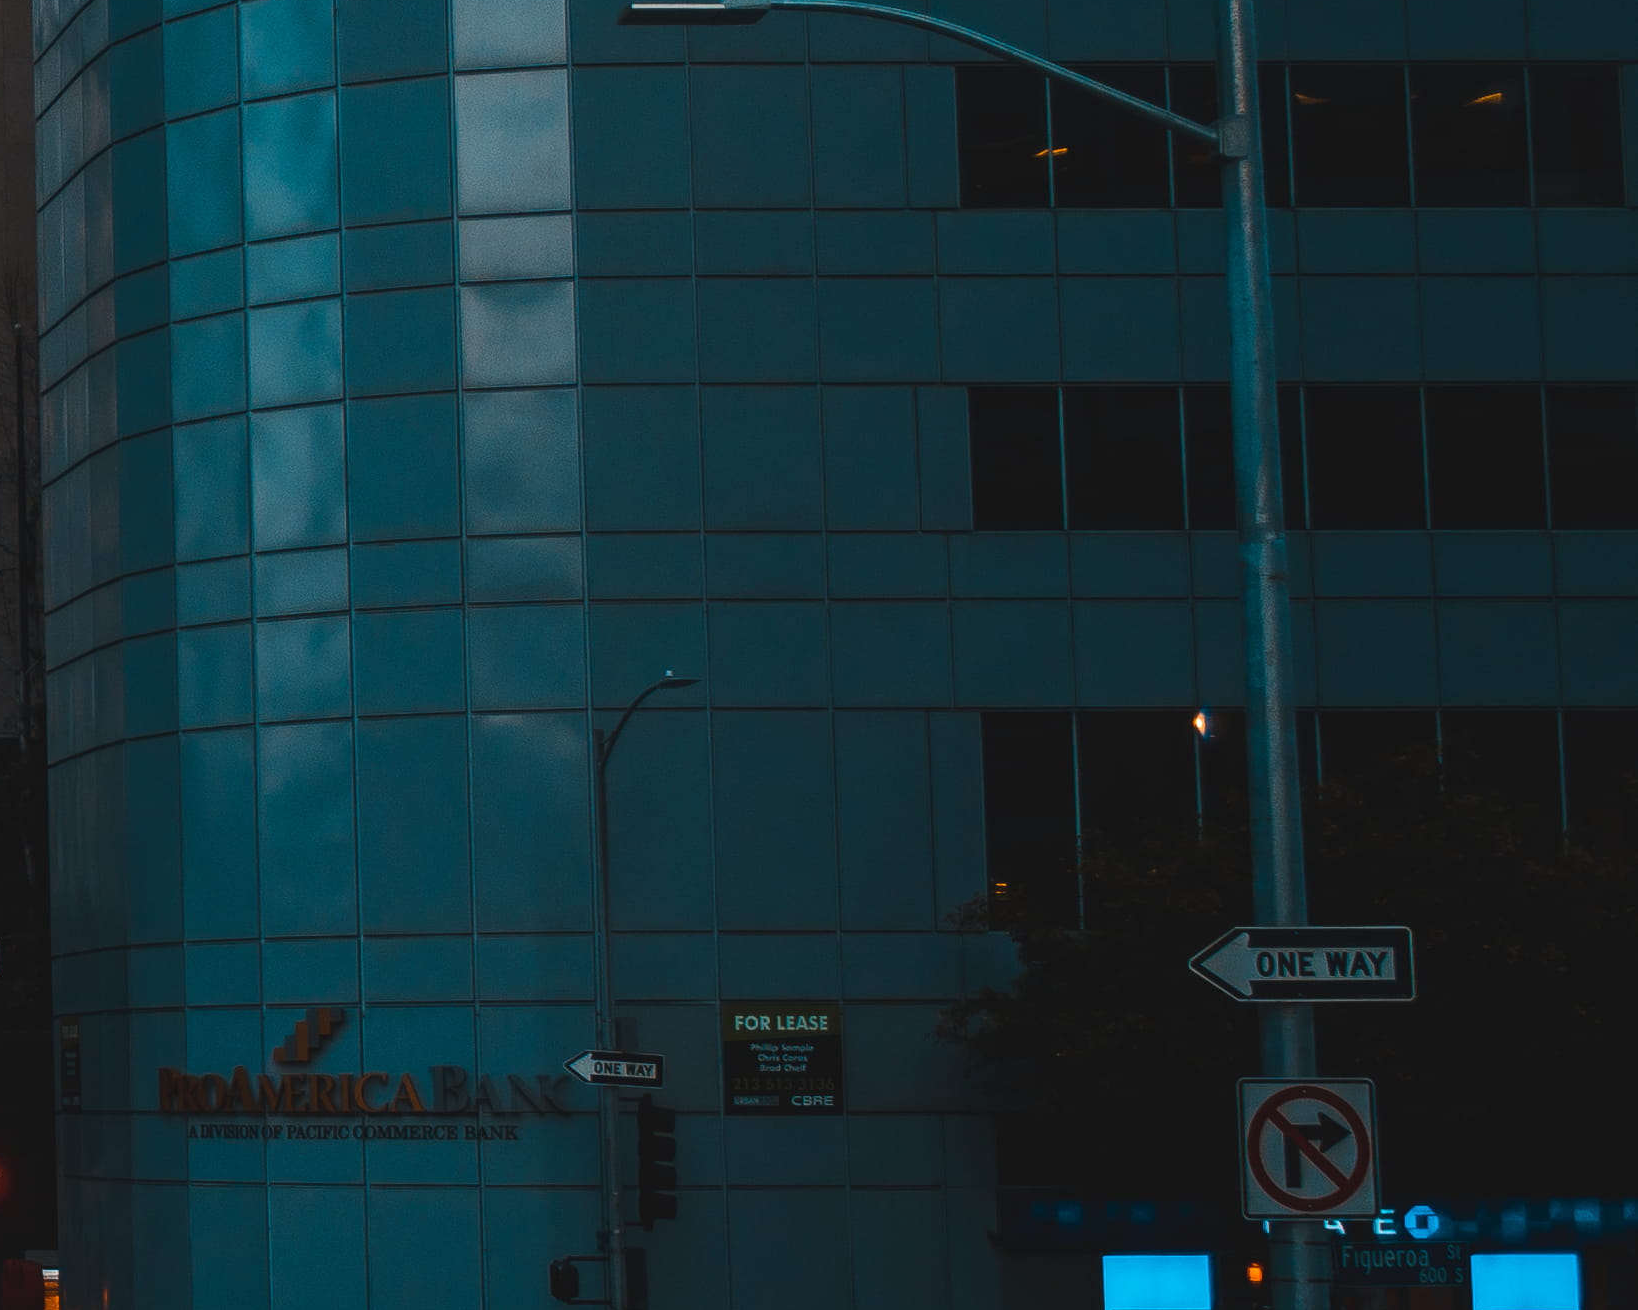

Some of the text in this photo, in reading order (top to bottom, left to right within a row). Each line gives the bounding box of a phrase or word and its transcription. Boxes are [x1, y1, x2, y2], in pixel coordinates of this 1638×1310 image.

[1256, 951, 1388, 977] ONE WAY
[734, 1015, 828, 1030] FOR LEASE
[594, 1061, 653, 1076] ONE WAY
[429, 1064, 573, 1115] BANK
[791, 1095, 835, 1106] CBRE
[189, 1124, 518, 1140] A DIVISION OF PACIFIC COMMERCE BANK
[1340, 1245, 1430, 1274] Figueroa
